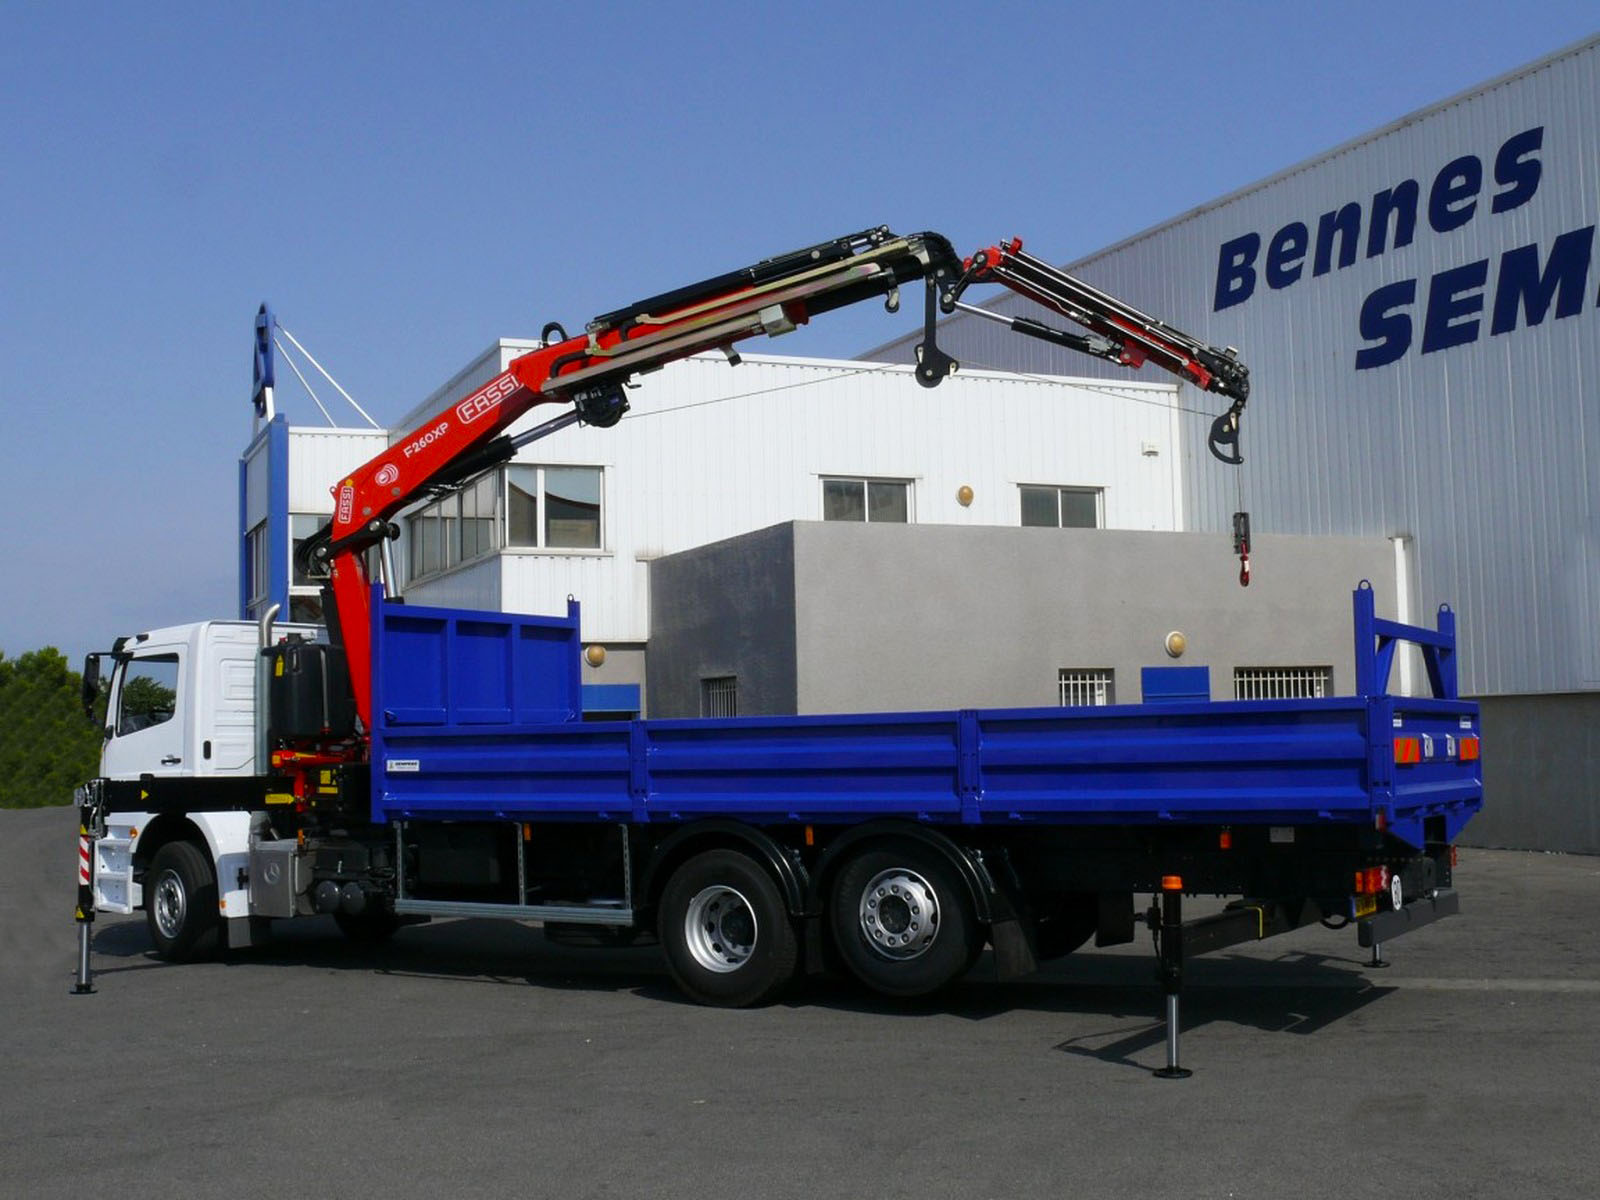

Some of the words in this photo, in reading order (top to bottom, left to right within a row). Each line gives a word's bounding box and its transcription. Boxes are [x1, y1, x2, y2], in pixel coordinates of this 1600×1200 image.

[1213, 126, 1545, 313] Bennes
[1355, 224, 1600, 371] SEM
[461, 375, 519, 420] FASSI
[403, 422, 449, 459] F260XP
[340, 488, 352, 521] FASSI
